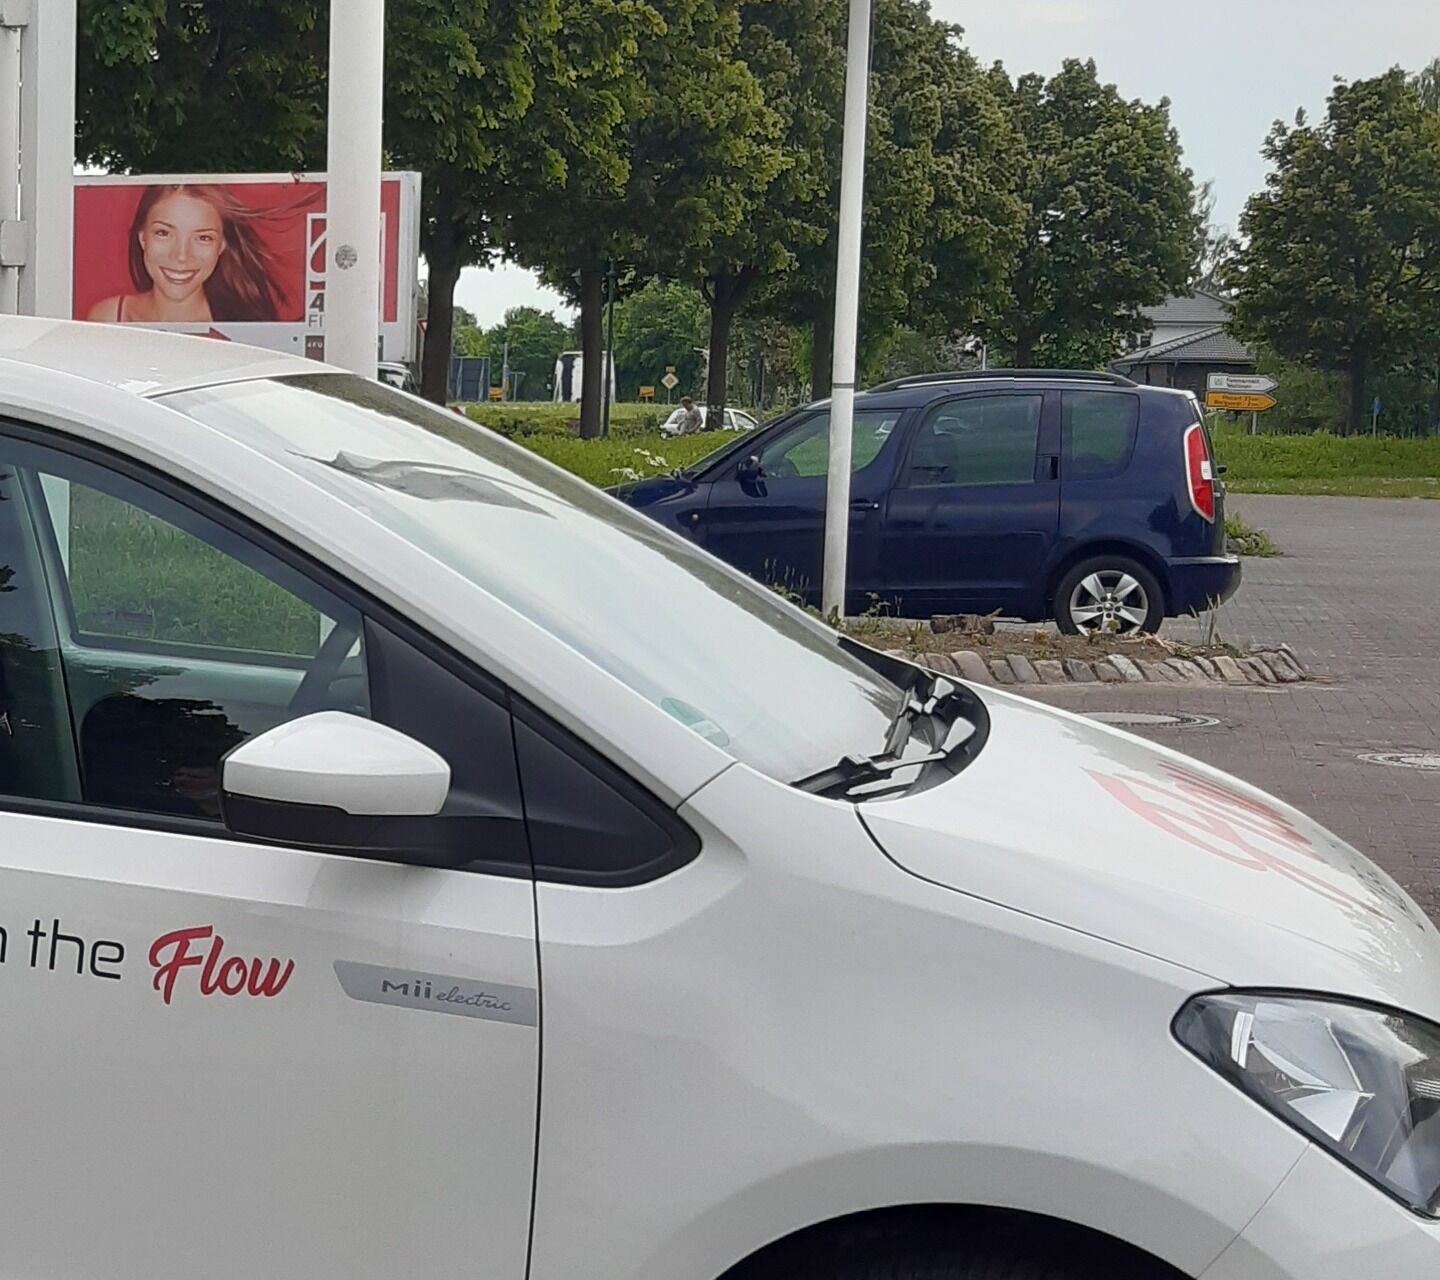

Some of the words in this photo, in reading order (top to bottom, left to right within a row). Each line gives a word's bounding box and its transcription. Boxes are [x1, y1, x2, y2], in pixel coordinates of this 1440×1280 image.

[27, 918, 125, 980] the
[148, 925, 296, 1005] Flow
[435, 986, 511, 1011] electric
